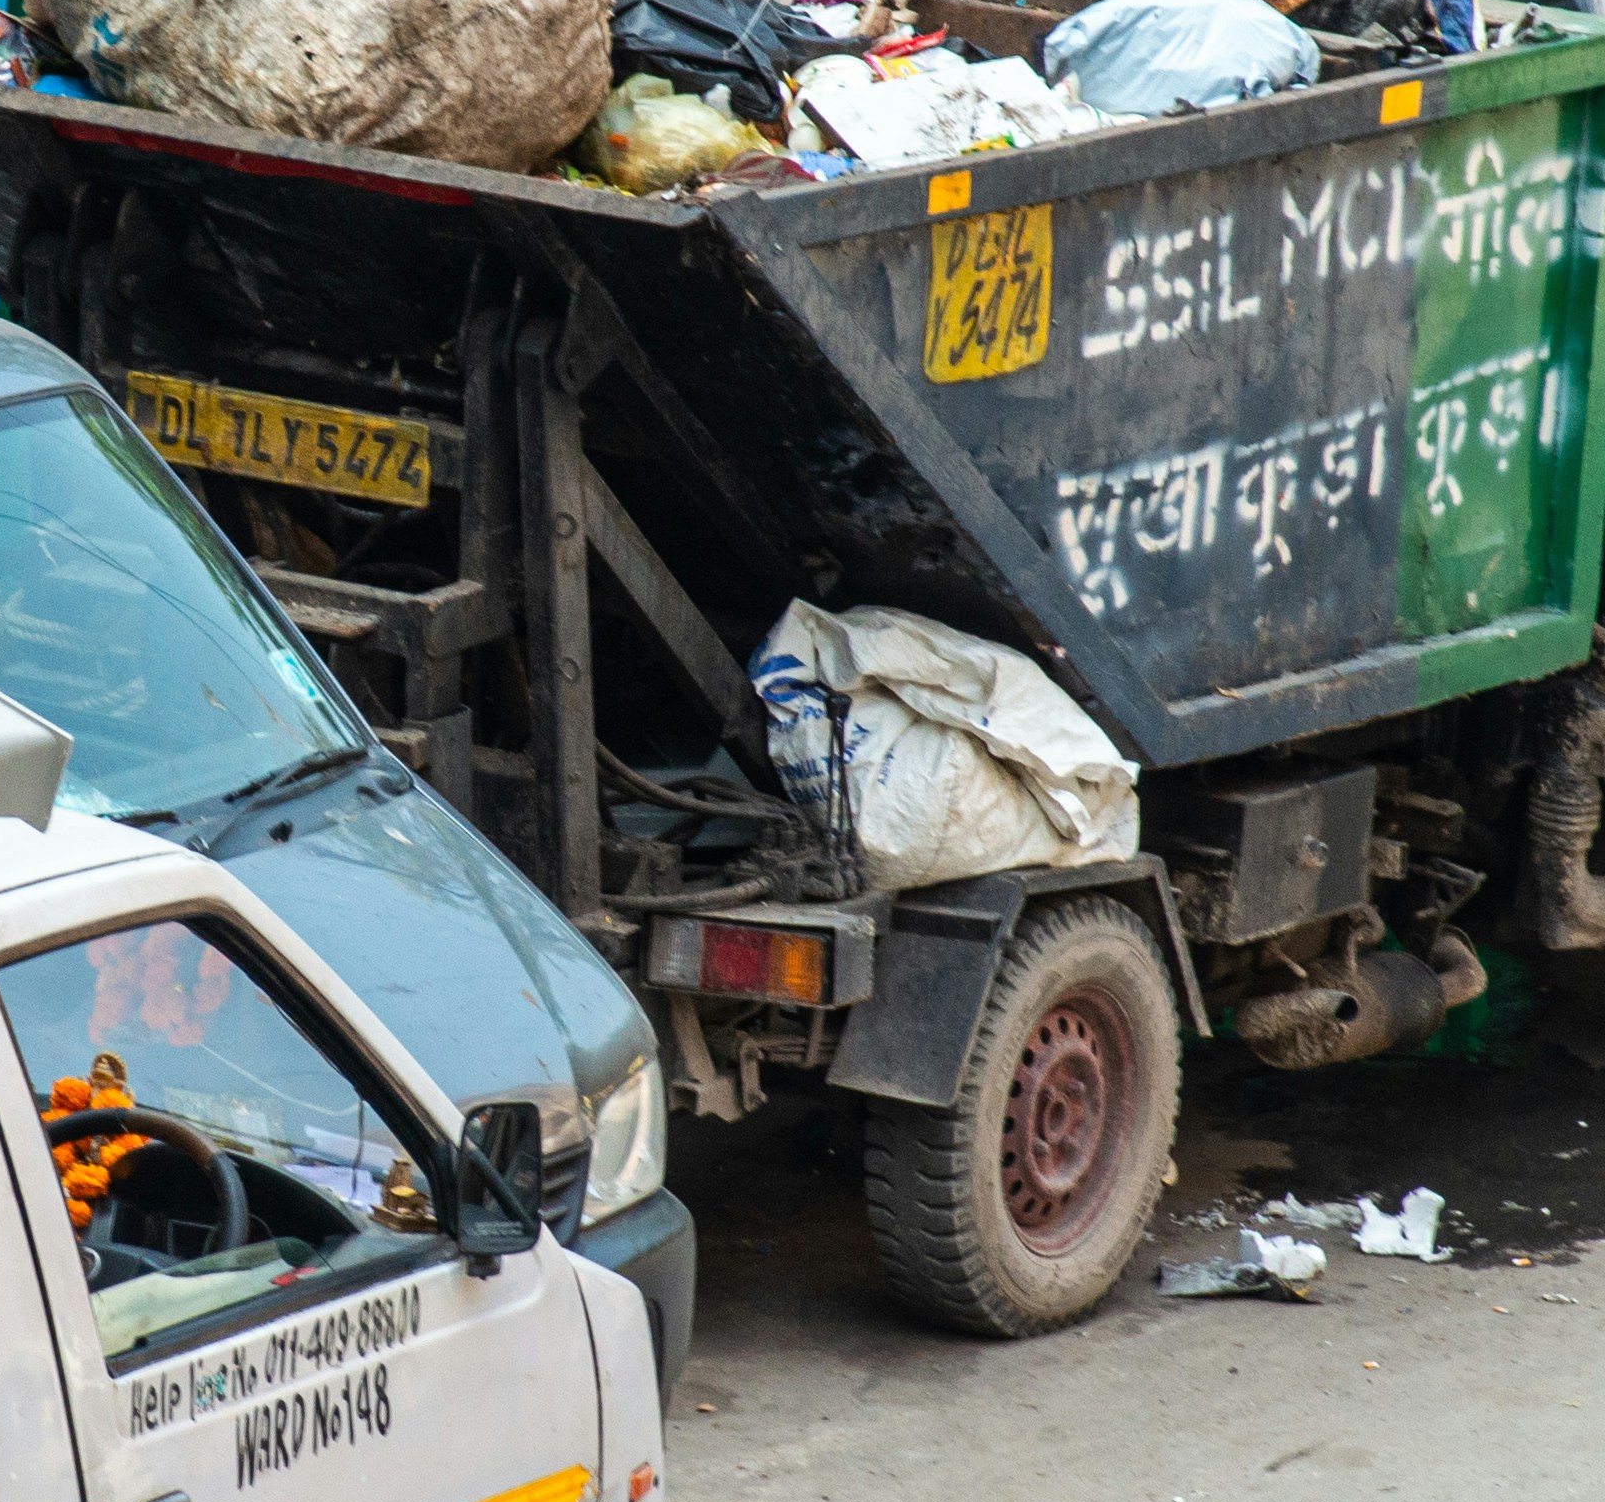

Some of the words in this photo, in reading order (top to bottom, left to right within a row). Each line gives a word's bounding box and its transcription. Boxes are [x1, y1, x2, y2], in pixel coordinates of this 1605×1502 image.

[313, 422, 425, 489] 5474
[130, 1370, 183, 1439] Help
[235, 1391, 305, 1491] WARD
